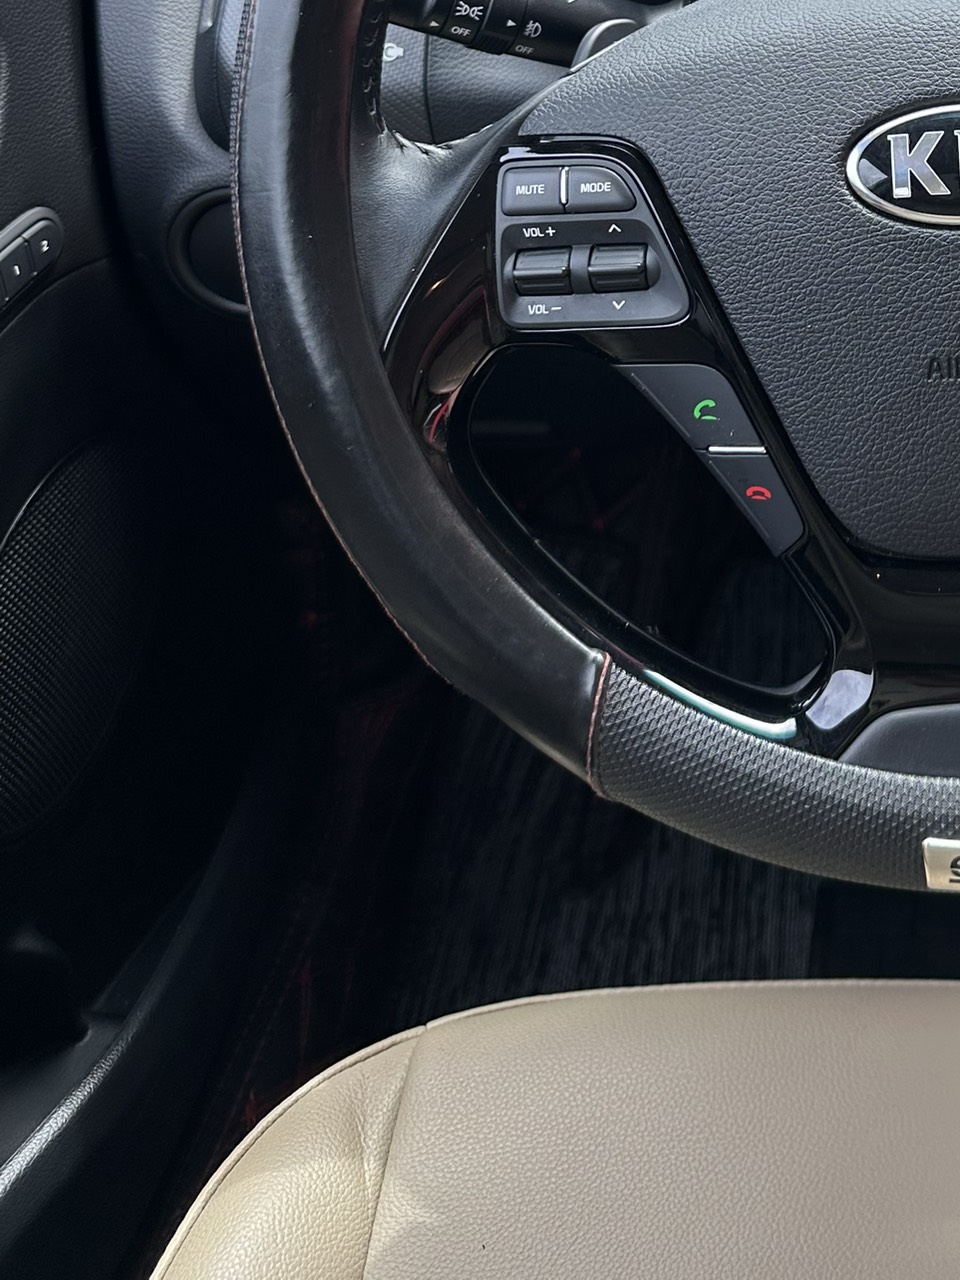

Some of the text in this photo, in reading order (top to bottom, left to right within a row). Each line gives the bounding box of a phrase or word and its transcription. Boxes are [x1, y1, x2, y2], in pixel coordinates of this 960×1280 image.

[451, 26, 472, 37] OFF
[515, 45, 534, 55] OFF
[515, 184, 545, 195] MUTE
[580, 182, 611, 193] MODE
[40, 240, 50, 253] 2
[14, 265, 21, 276] 1
